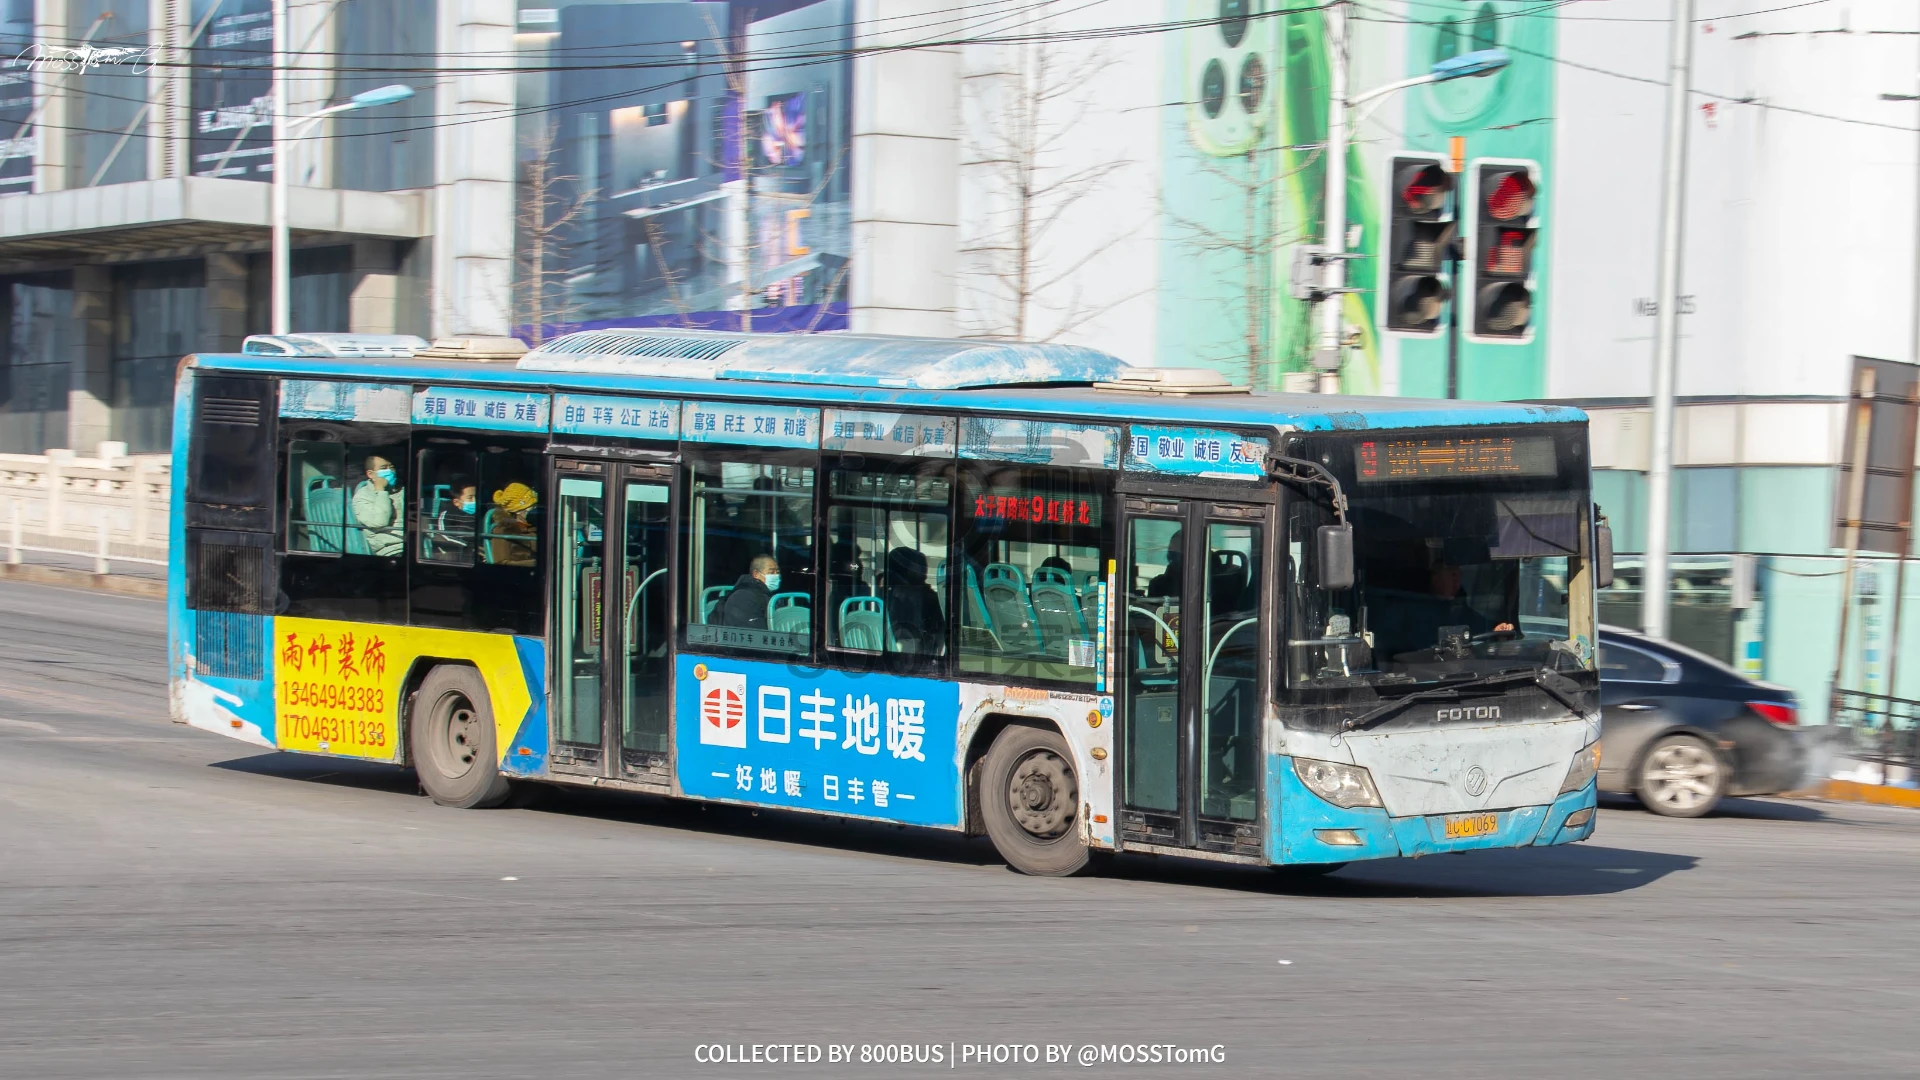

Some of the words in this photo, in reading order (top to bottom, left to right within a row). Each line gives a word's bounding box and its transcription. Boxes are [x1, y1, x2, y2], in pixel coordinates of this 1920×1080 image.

[424, 397, 447, 415] 爱国
[454, 399, 477, 417] 敬业
[484, 401, 507, 419] 诚信
[514, 402, 538, 422] 友善
[565, 404, 586, 423] 自由
[593, 406, 615, 425] 平等
[621, 408, 642, 427] 公正
[648, 410, 670, 428] 法治
[694, 412, 716, 432] 富强
[724, 414, 746, 433] 民主
[754, 415, 776, 435] 文明
[784, 417, 807, 437] 和谐
[833, 420, 855, 440] 爱国
[863, 422, 885, 441] 敬业
[893, 424, 914, 444] 诚信
[923, 426, 945, 446] 友善
[1158, 437, 1185, 459] 敬业
[1194, 439, 1221, 461] 诚信
[282, 631, 386, 684] 雨竹装饰
[283, 680, 384, 714] 13464943383
[758, 684, 926, 763] 日丰地暖
[1437, 705, 1501, 722] FOTON
[283, 714, 386, 747] 17046311333
